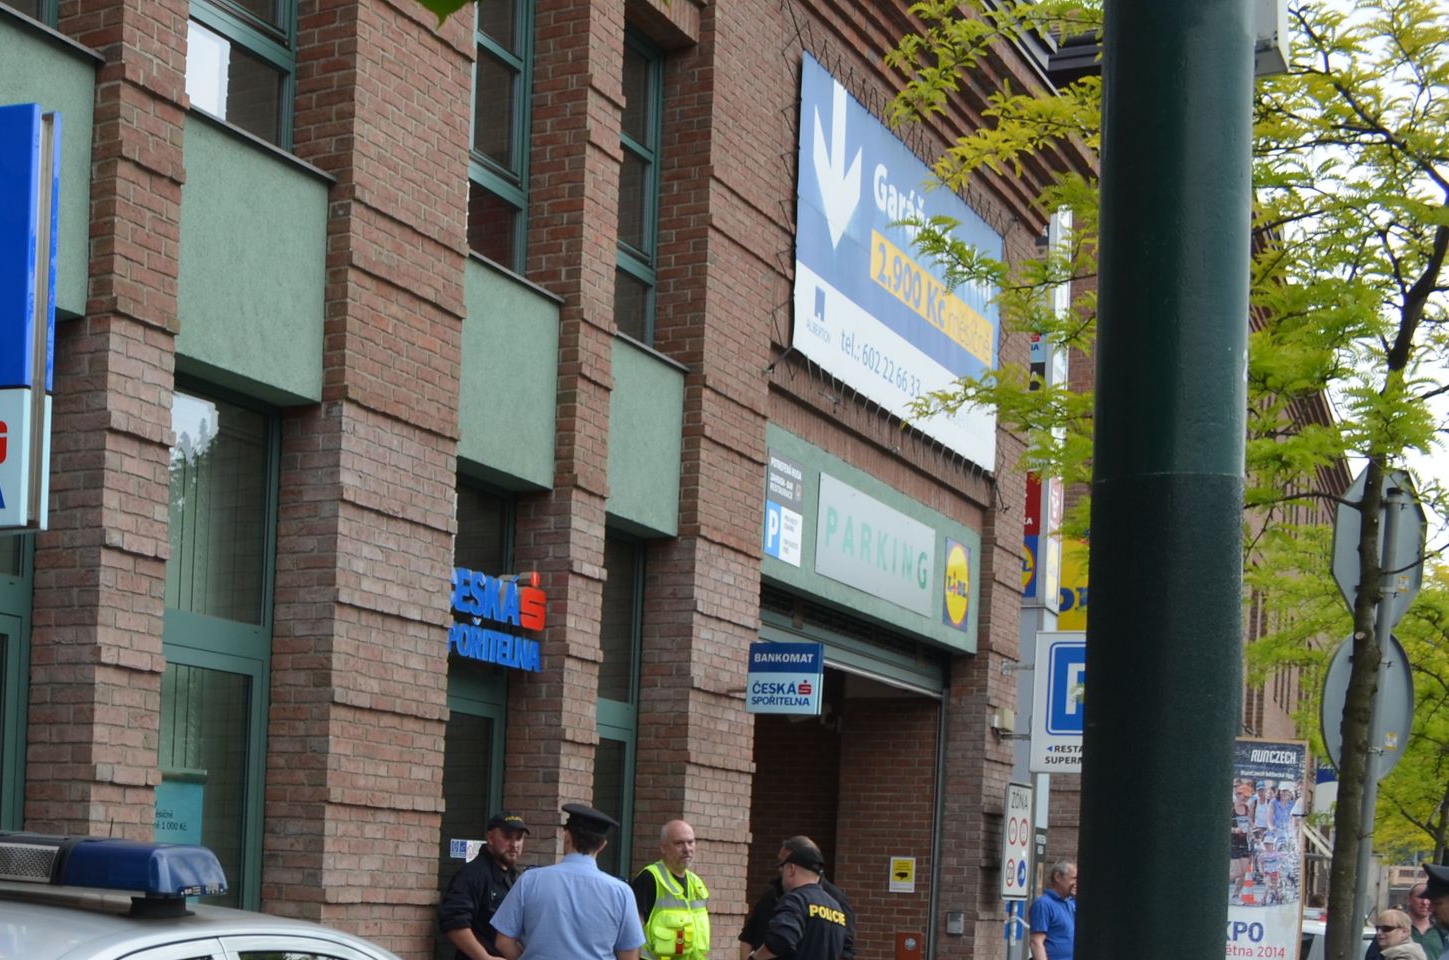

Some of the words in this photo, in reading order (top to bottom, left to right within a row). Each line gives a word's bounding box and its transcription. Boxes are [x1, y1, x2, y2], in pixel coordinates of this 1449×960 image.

[877, 242, 922, 310] 2.900
[862, 343, 881, 374] 602
[883, 356, 894, 384] 22
[896, 367, 908, 391] 66
[910, 375, 921, 398] 33
[767, 508, 779, 549] P
[825, 504, 929, 591] PARKING
[947, 570, 967, 598] LIDL
[447, 616, 542, 673] POŘITELNA
[753, 652, 814, 664] BANKOMAT
[751, 680, 797, 695] ČESKÁ
[751, 695, 811, 707] SPOŘITELNA
[1250, 749, 1297, 765] RUNCZECH
[1010, 789, 1029, 811] ZÓNA
[1257, 946, 1287, 959] 2014
